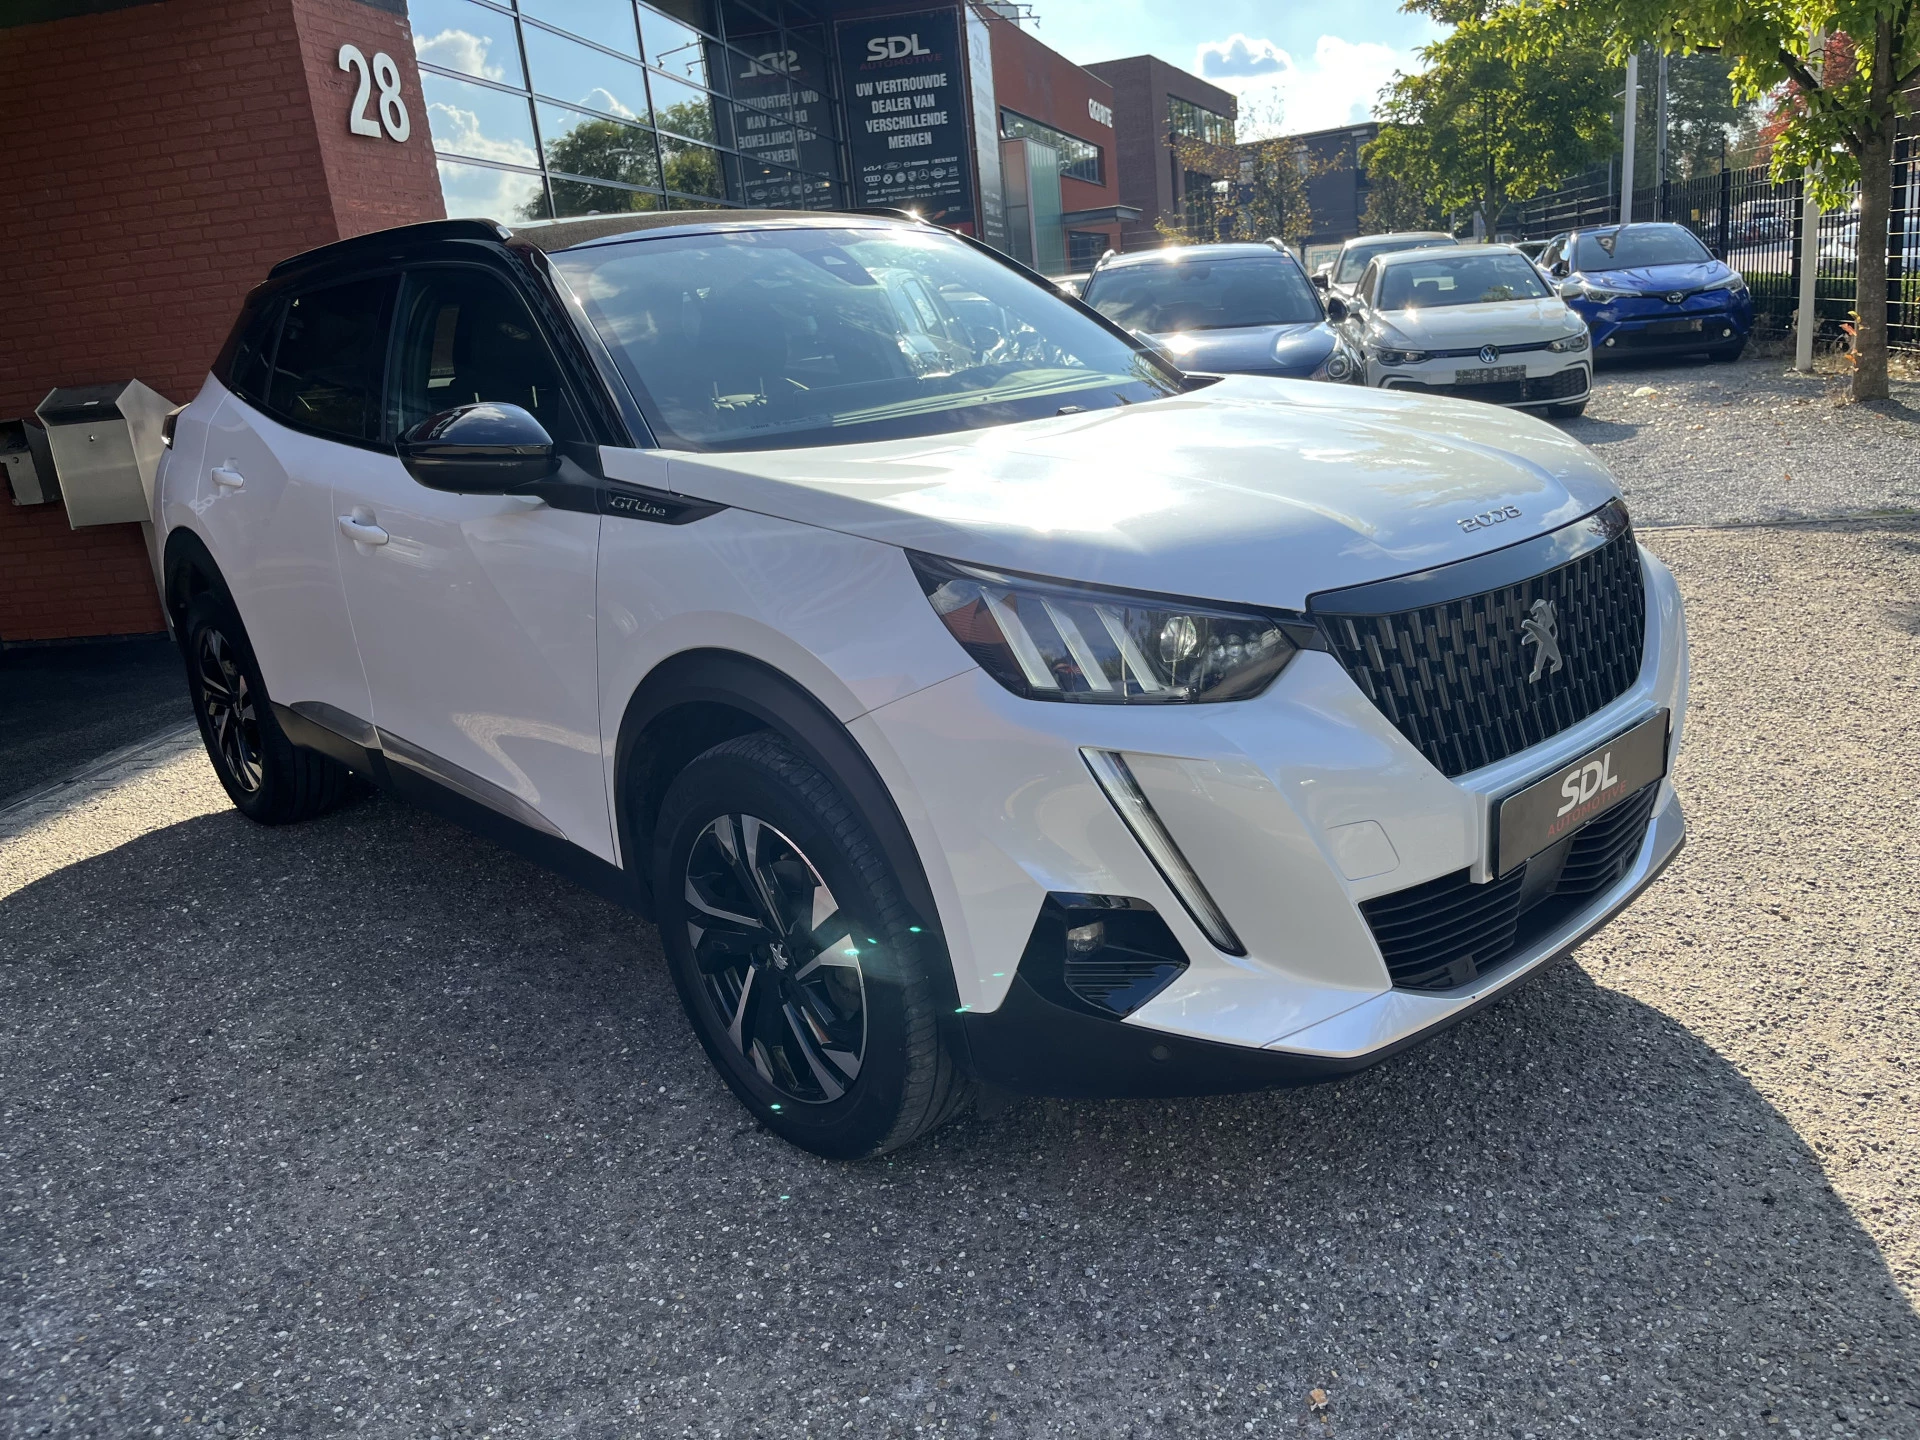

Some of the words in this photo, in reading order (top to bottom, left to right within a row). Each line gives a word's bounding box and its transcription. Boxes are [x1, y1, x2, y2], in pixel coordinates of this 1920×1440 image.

[867, 34, 930, 61] SDL
[860, 53, 943, 71] AUTOMOTIVE
[339, 44, 411, 142] 28
[856, 82, 873, 97] UW
[876, 73, 947, 94] VERTROUWDE
[871, 97, 911, 114] DEALER
[913, 94, 935, 109] VAN
[865, 111, 948, 133] VERSCHILLENDE
[888, 132, 932, 149] MERKEN
[1557, 752, 1617, 817] SDL
[1547, 780, 1627, 838] AUTOMOTIVE
